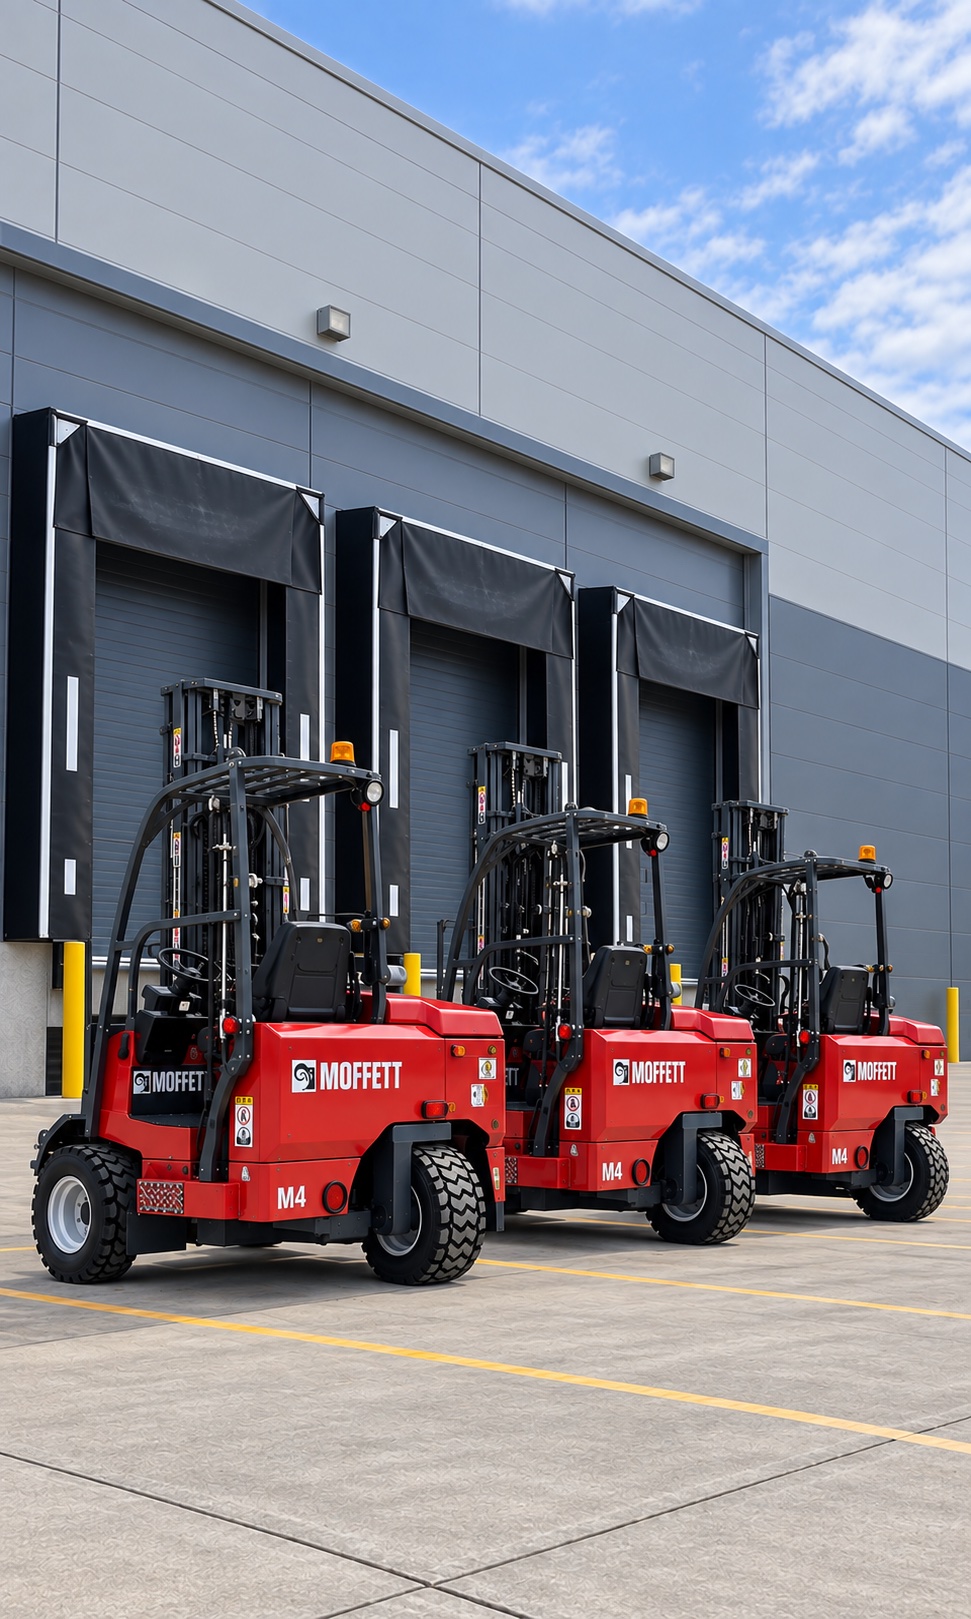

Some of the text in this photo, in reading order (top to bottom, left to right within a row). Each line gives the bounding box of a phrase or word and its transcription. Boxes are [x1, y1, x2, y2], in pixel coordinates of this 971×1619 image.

[152, 1070, 207, 1093] MOFFET
[320, 1061, 402, 1090] MOFFETT
[631, 1061, 686, 1084] MOFFETT
[857, 1061, 897, 1081] MOFFETT
[831, 1147, 848, 1165] M4
[602, 1161, 623, 1181] M4
[277, 1185, 307, 1210] M4
